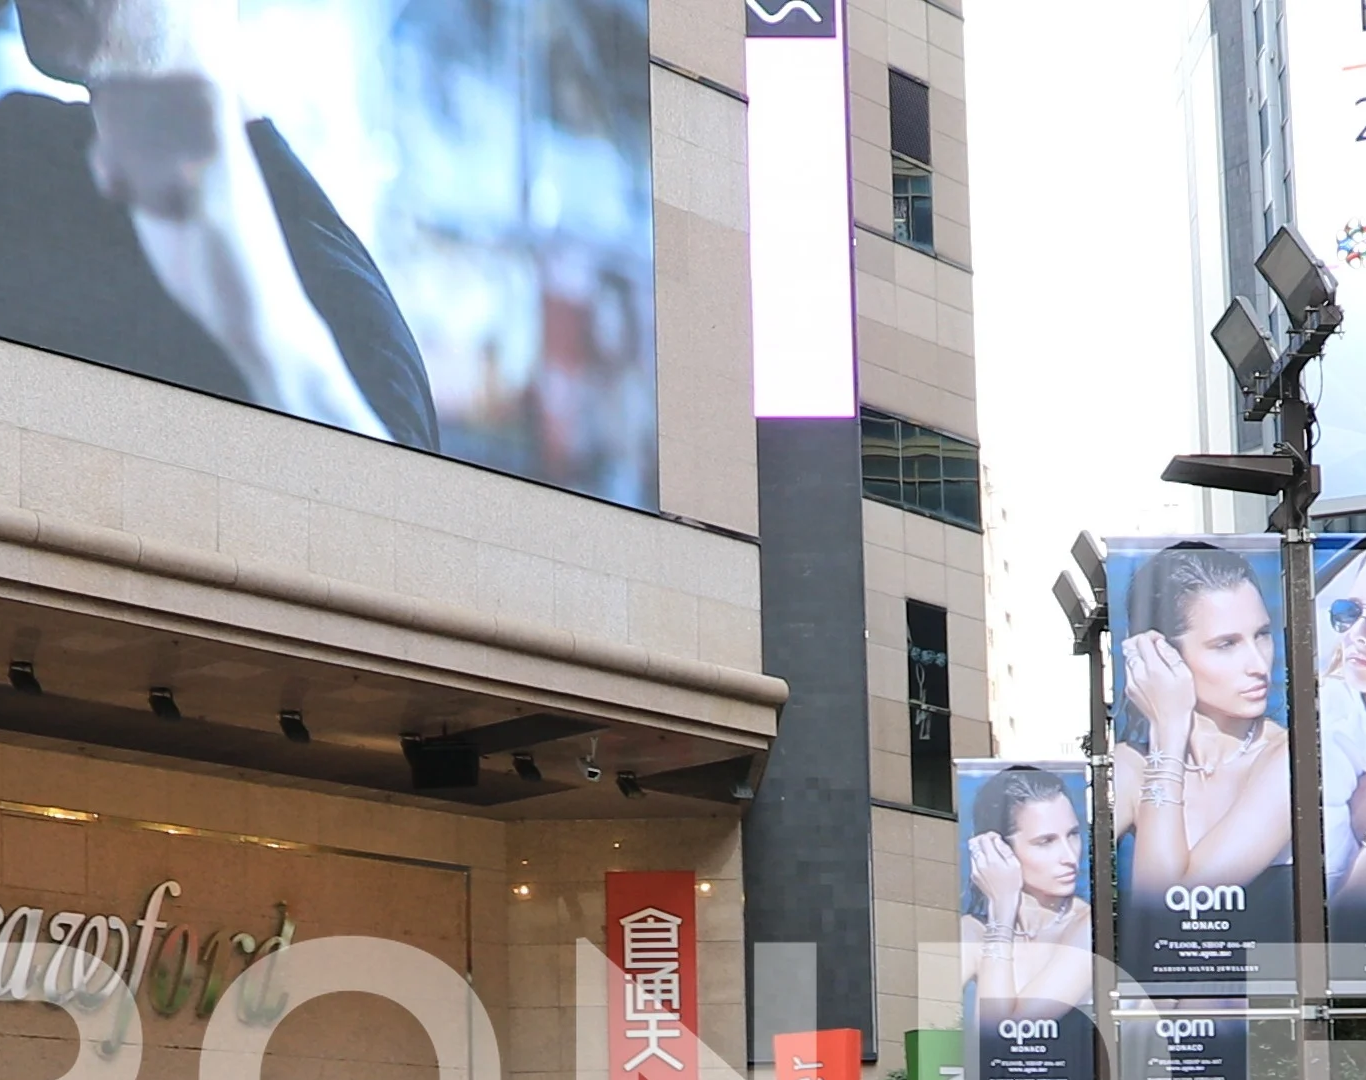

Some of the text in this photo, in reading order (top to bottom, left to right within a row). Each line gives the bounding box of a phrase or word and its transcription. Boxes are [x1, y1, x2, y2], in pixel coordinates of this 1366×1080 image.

[1165, 885, 1246, 920] apm
[1181, 921, 1230, 930] MONACO
[998, 1019, 1059, 1045] apm
[1156, 1019, 1215, 1044] apm
